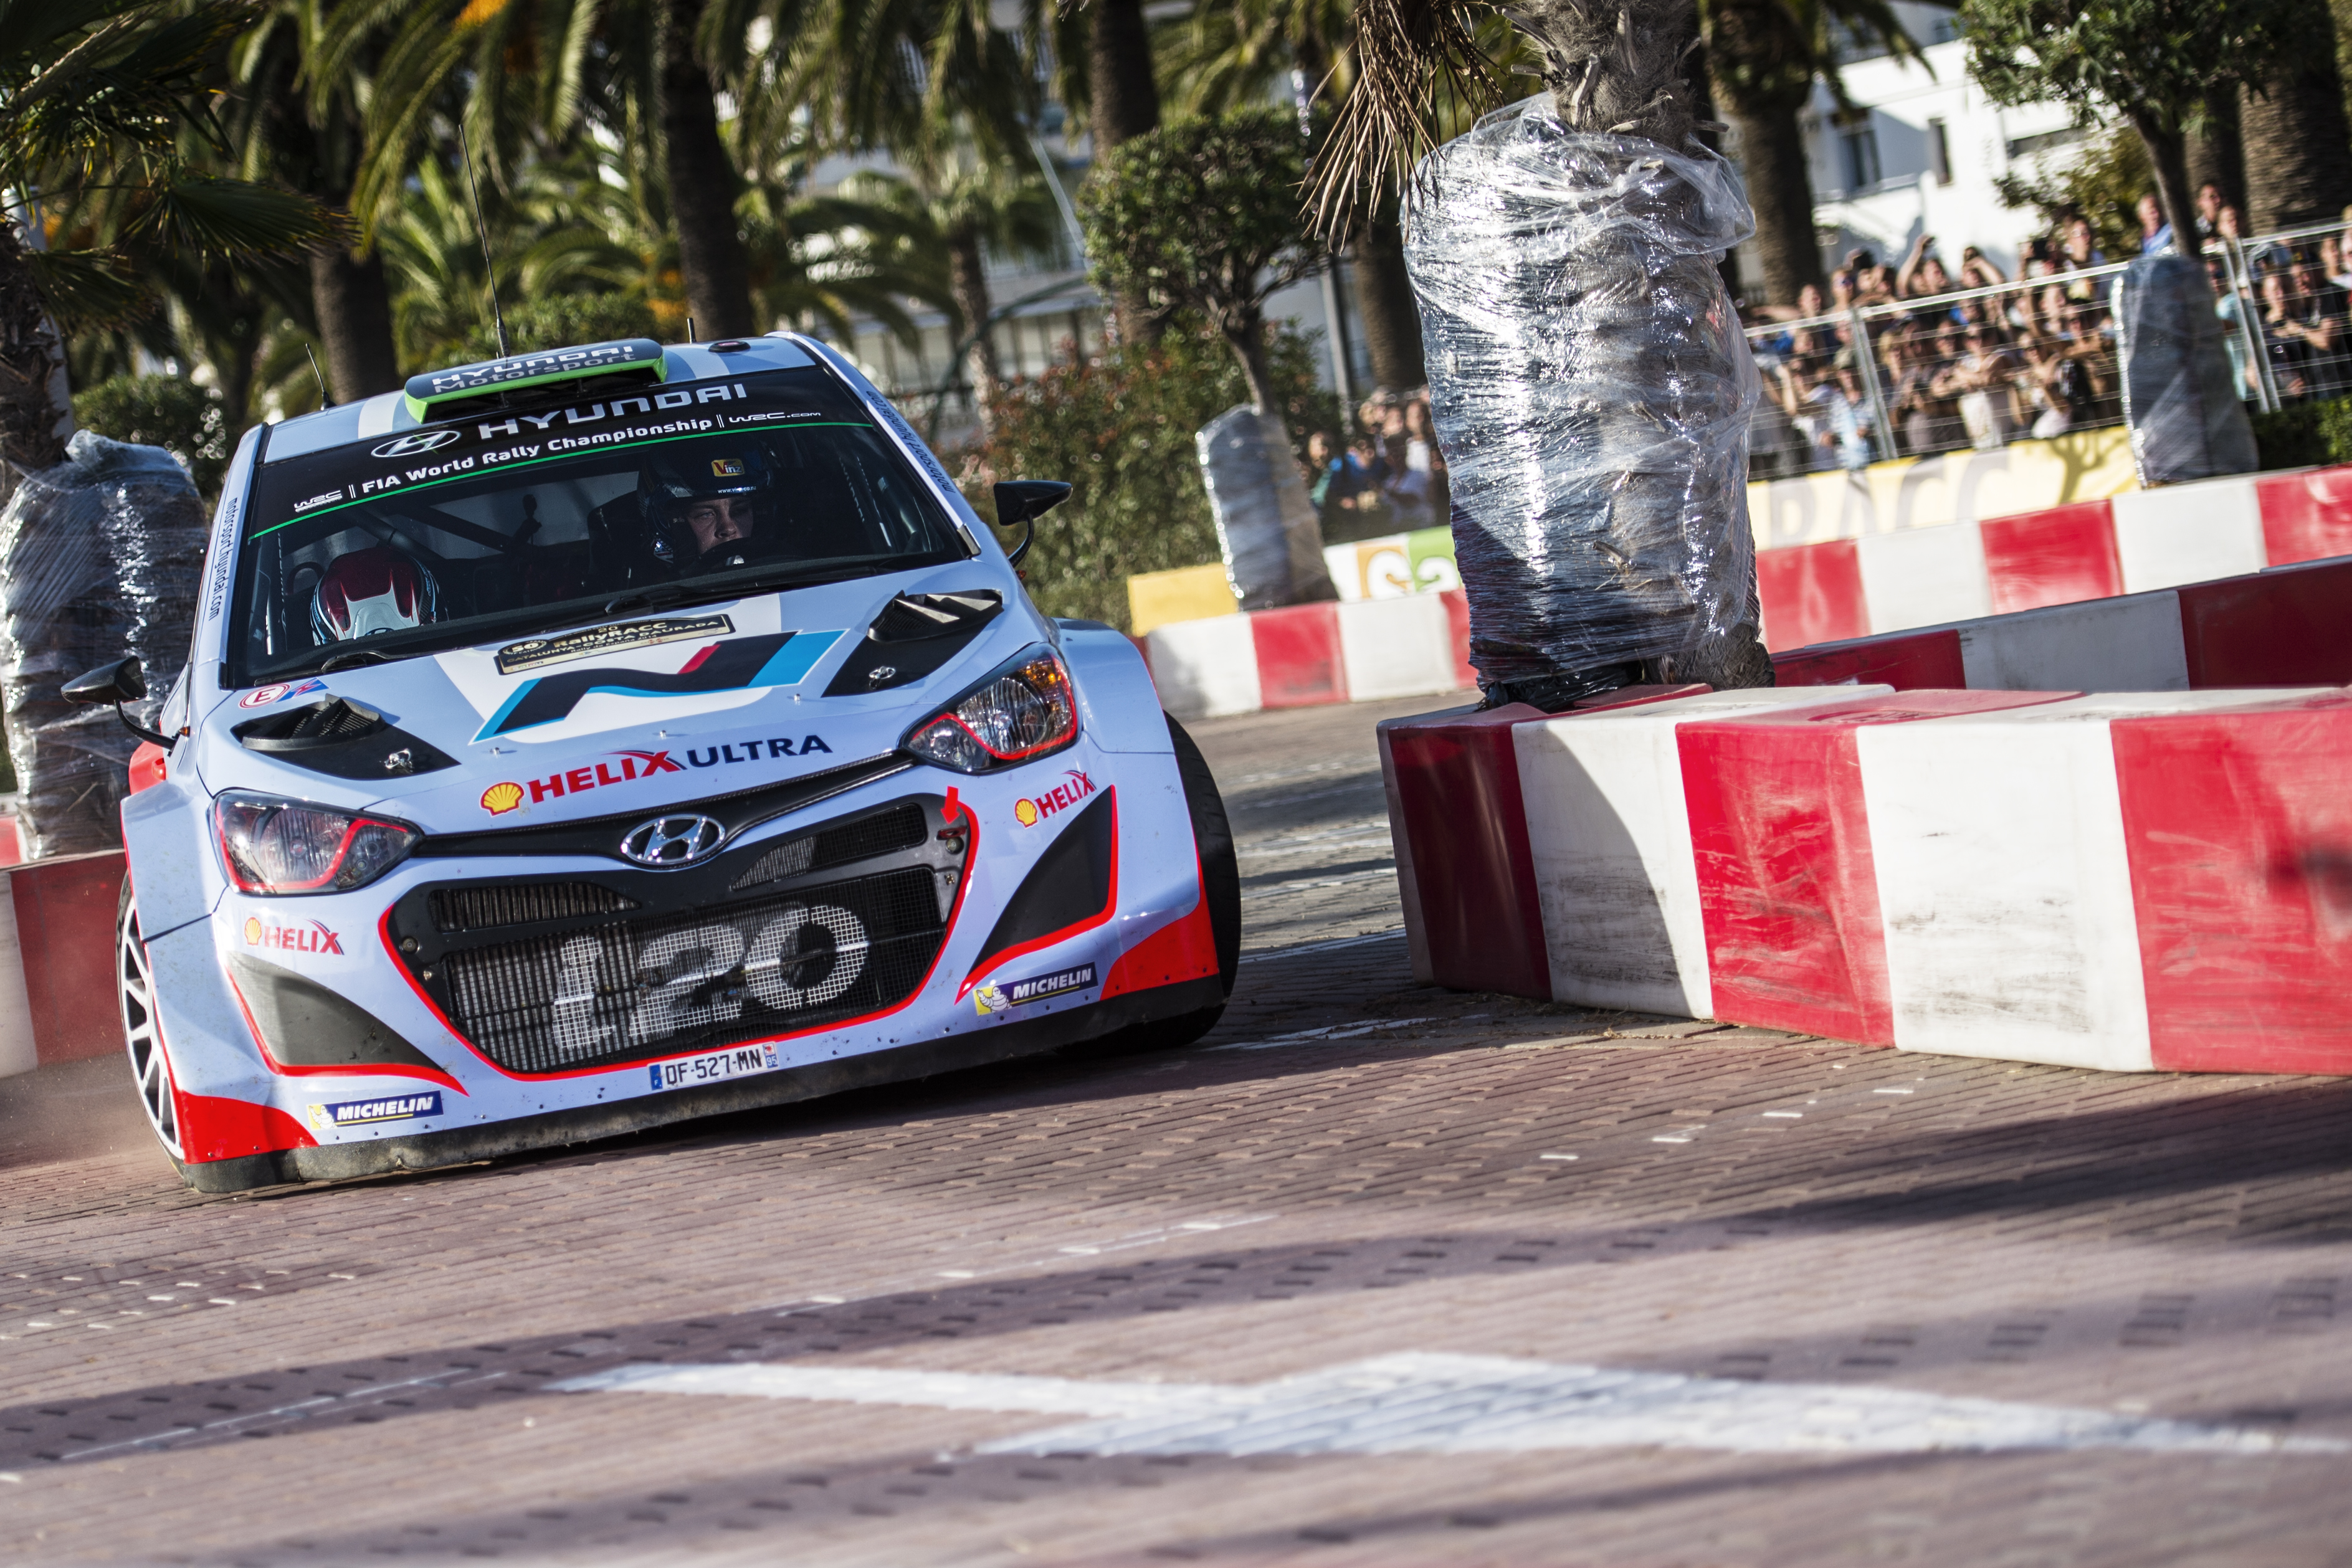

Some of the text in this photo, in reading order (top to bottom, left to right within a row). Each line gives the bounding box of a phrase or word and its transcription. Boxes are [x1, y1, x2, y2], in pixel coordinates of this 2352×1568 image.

[432, 346, 633, 385] HYUNDAI
[435, 353, 636, 393] Motorsport
[478, 384, 747, 440] HYUNDAI
[362, 476, 401, 493] FIA
[406, 457, 474, 481] World
[482, 445, 540, 465] Rally
[548, 419, 712, 452] Championship
[713, 461, 742, 475] Vinz
[512, 642, 539, 653] 50
[553, 622, 667, 648] RallyRACC
[639, 621, 718, 637] DAURADA
[252, 688, 277, 703] E
[526, 734, 834, 804] HELIX ULTRA
[1035, 770, 1097, 819] HELIX
[264, 918, 345, 956] HELIX
[1013, 967, 1092, 999] MICHELIN
[665, 1048, 763, 1085] DF-527-MN
[766, 1055, 778, 1066] 95
[336, 1096, 434, 1121] MICHELIN
